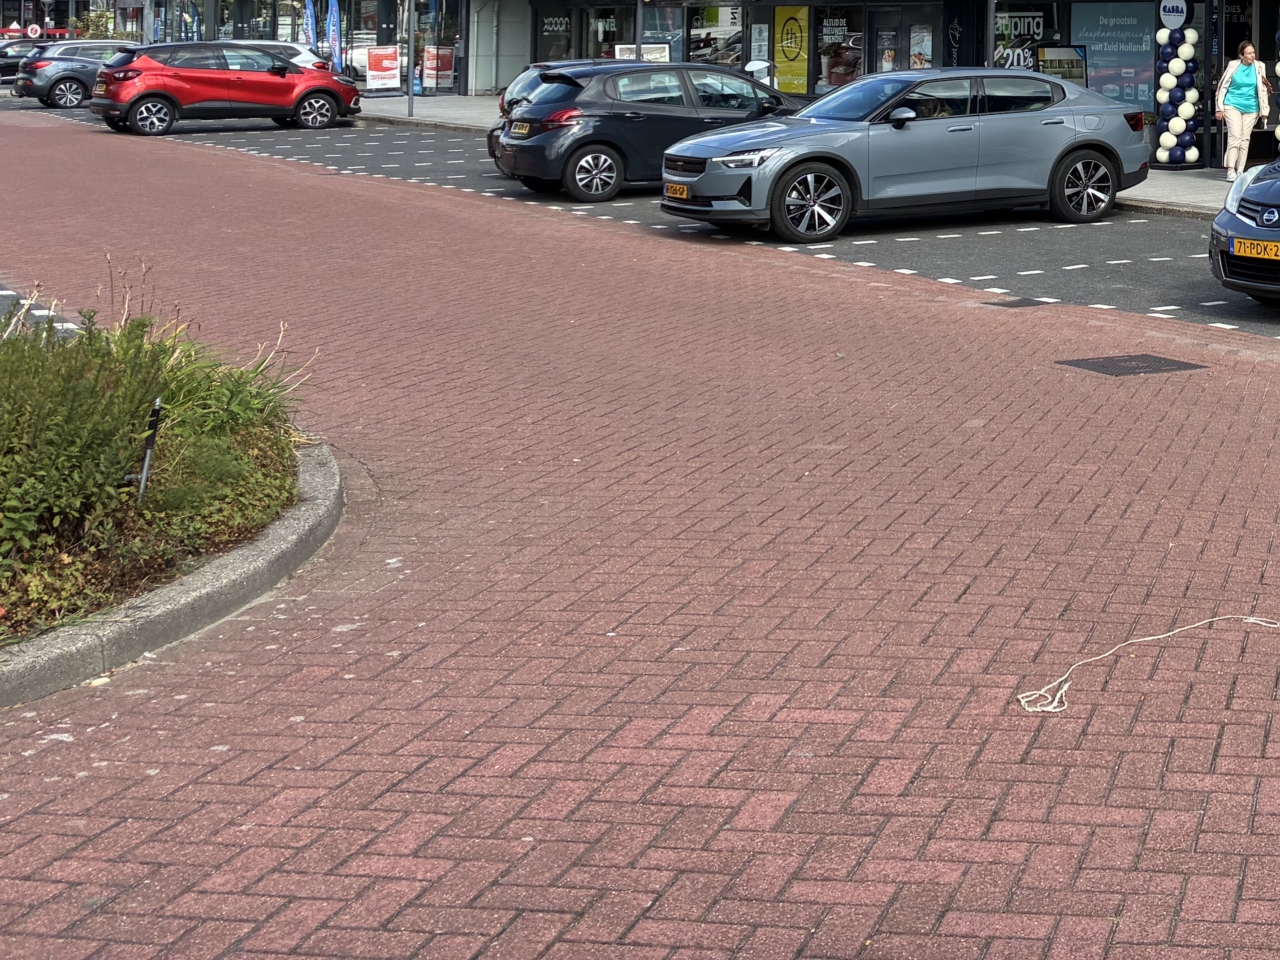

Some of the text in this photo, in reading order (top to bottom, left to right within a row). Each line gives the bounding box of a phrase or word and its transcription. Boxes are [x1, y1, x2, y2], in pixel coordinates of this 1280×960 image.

[837, 18, 847, 26] DE
[1099, 16, 1138, 27] De grootste
[822, 26, 848, 35] NIEUWSTE
[1091, 42, 1146, 52] van Zuid Holland
[1237, 240, 1280, 258] 71-PDK-2
